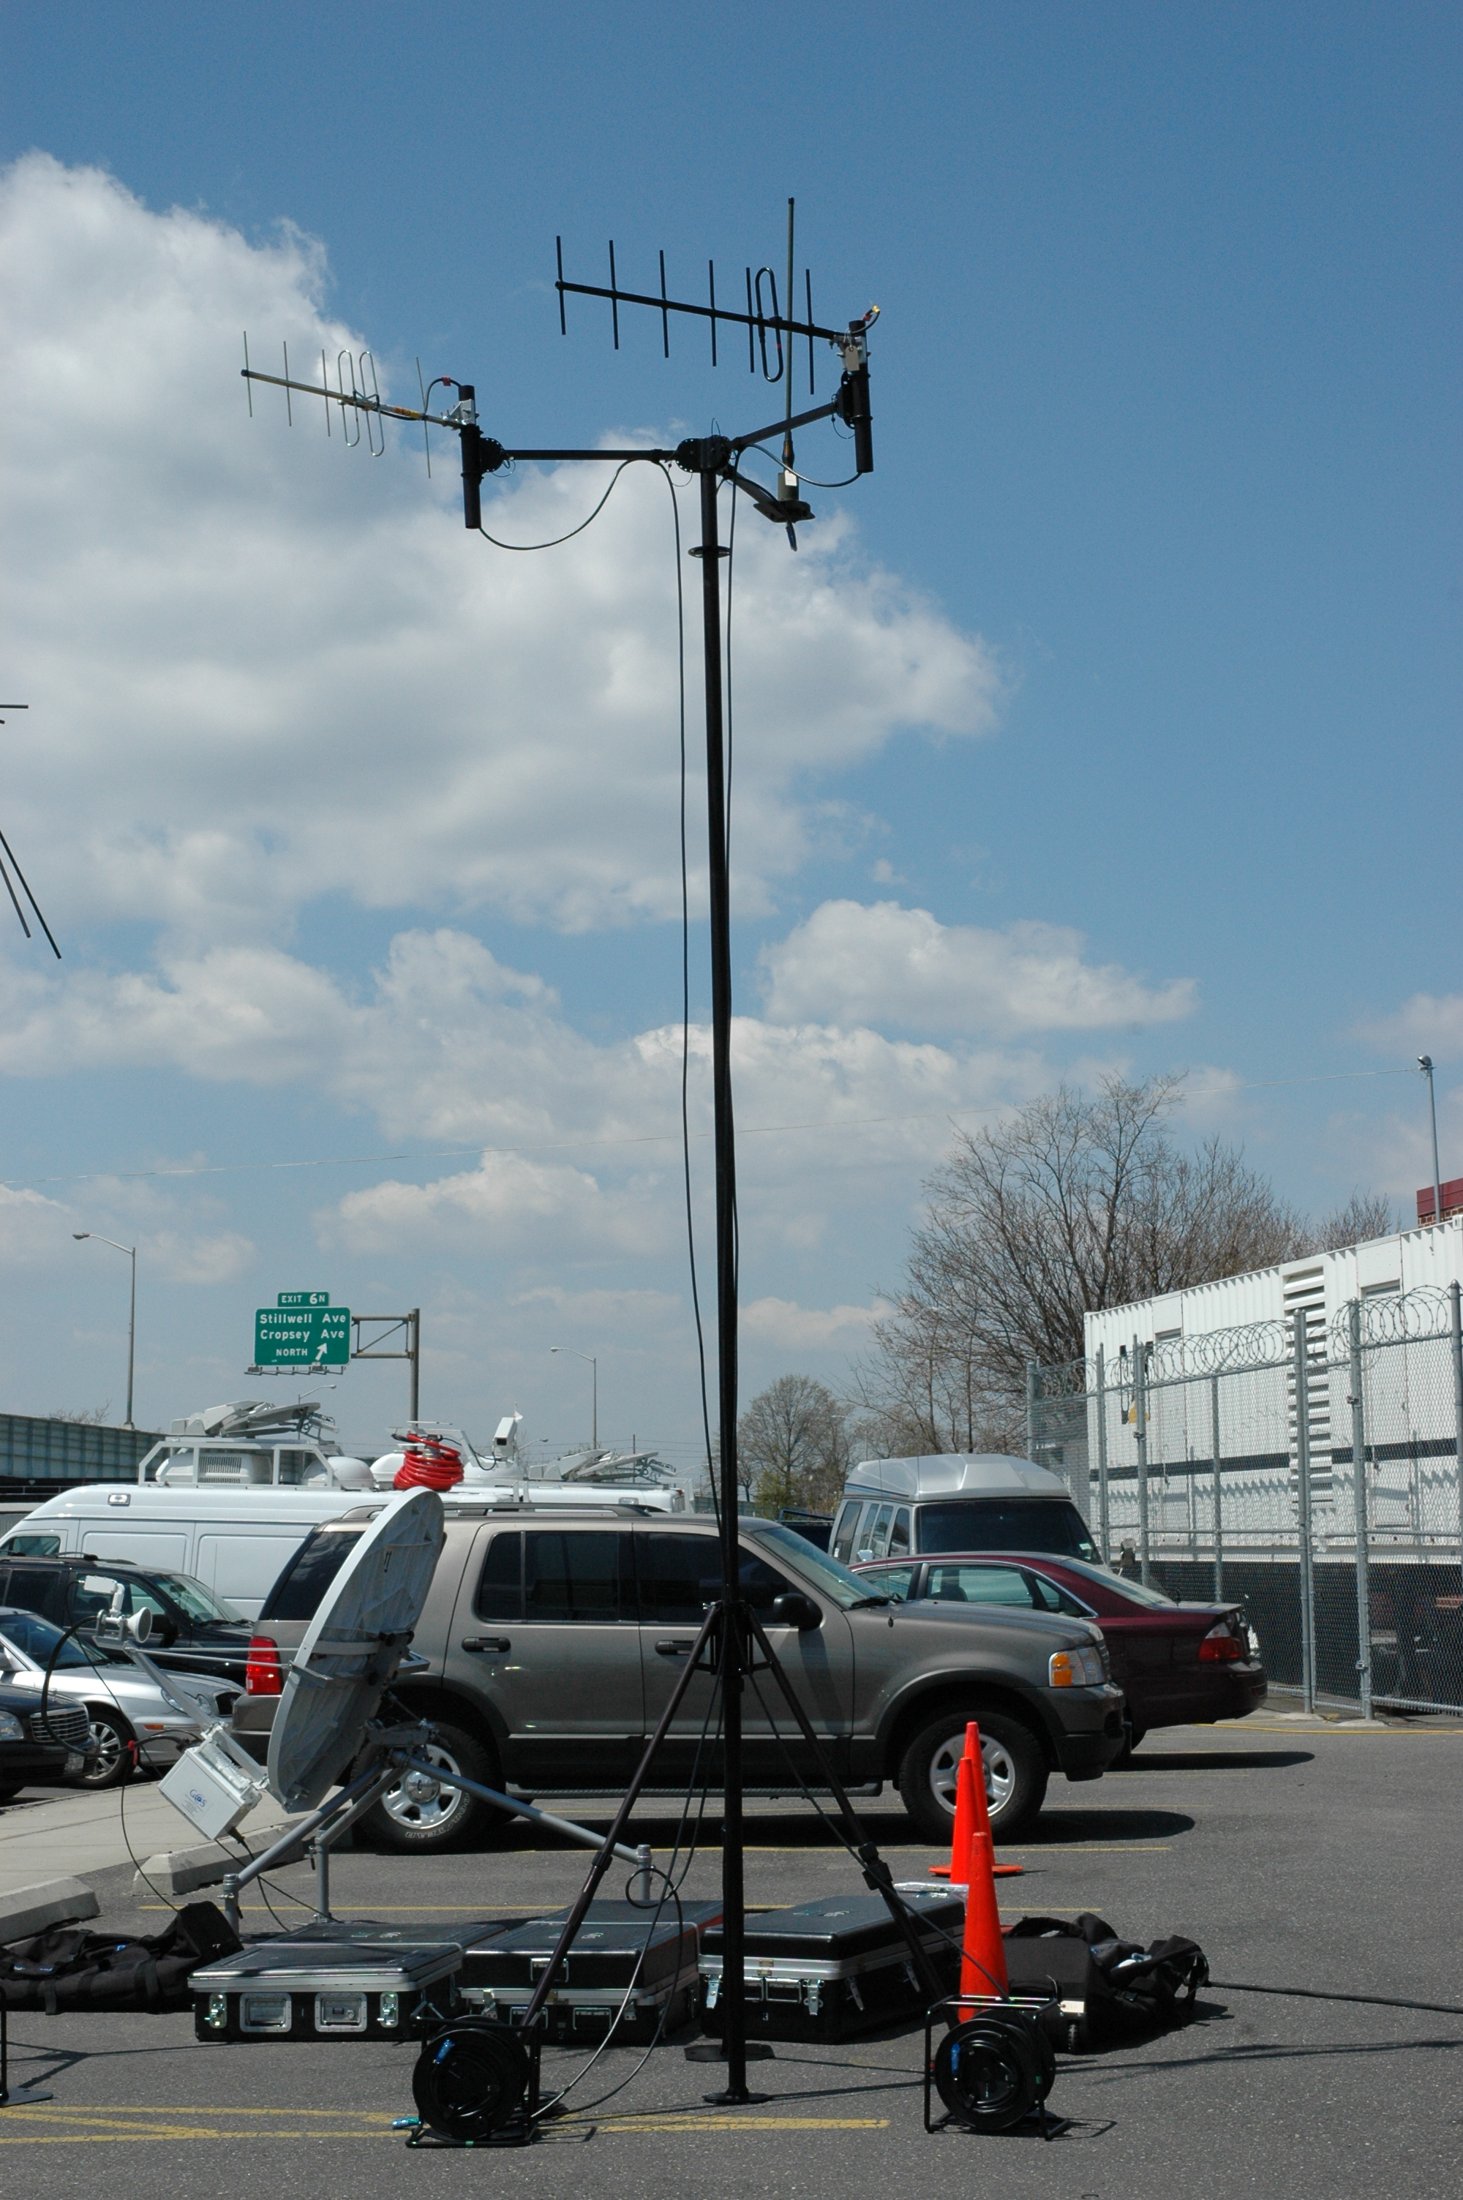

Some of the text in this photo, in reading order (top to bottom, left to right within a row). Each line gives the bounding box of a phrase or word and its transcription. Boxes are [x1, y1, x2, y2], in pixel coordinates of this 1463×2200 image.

[281, 1295, 303, 1303] EXIT
[259, 1313, 347, 1324] Stillwell Ave
[260, 1329, 345, 1342] Cropsey Ave
[275, 1348, 308, 1357] NORTH
